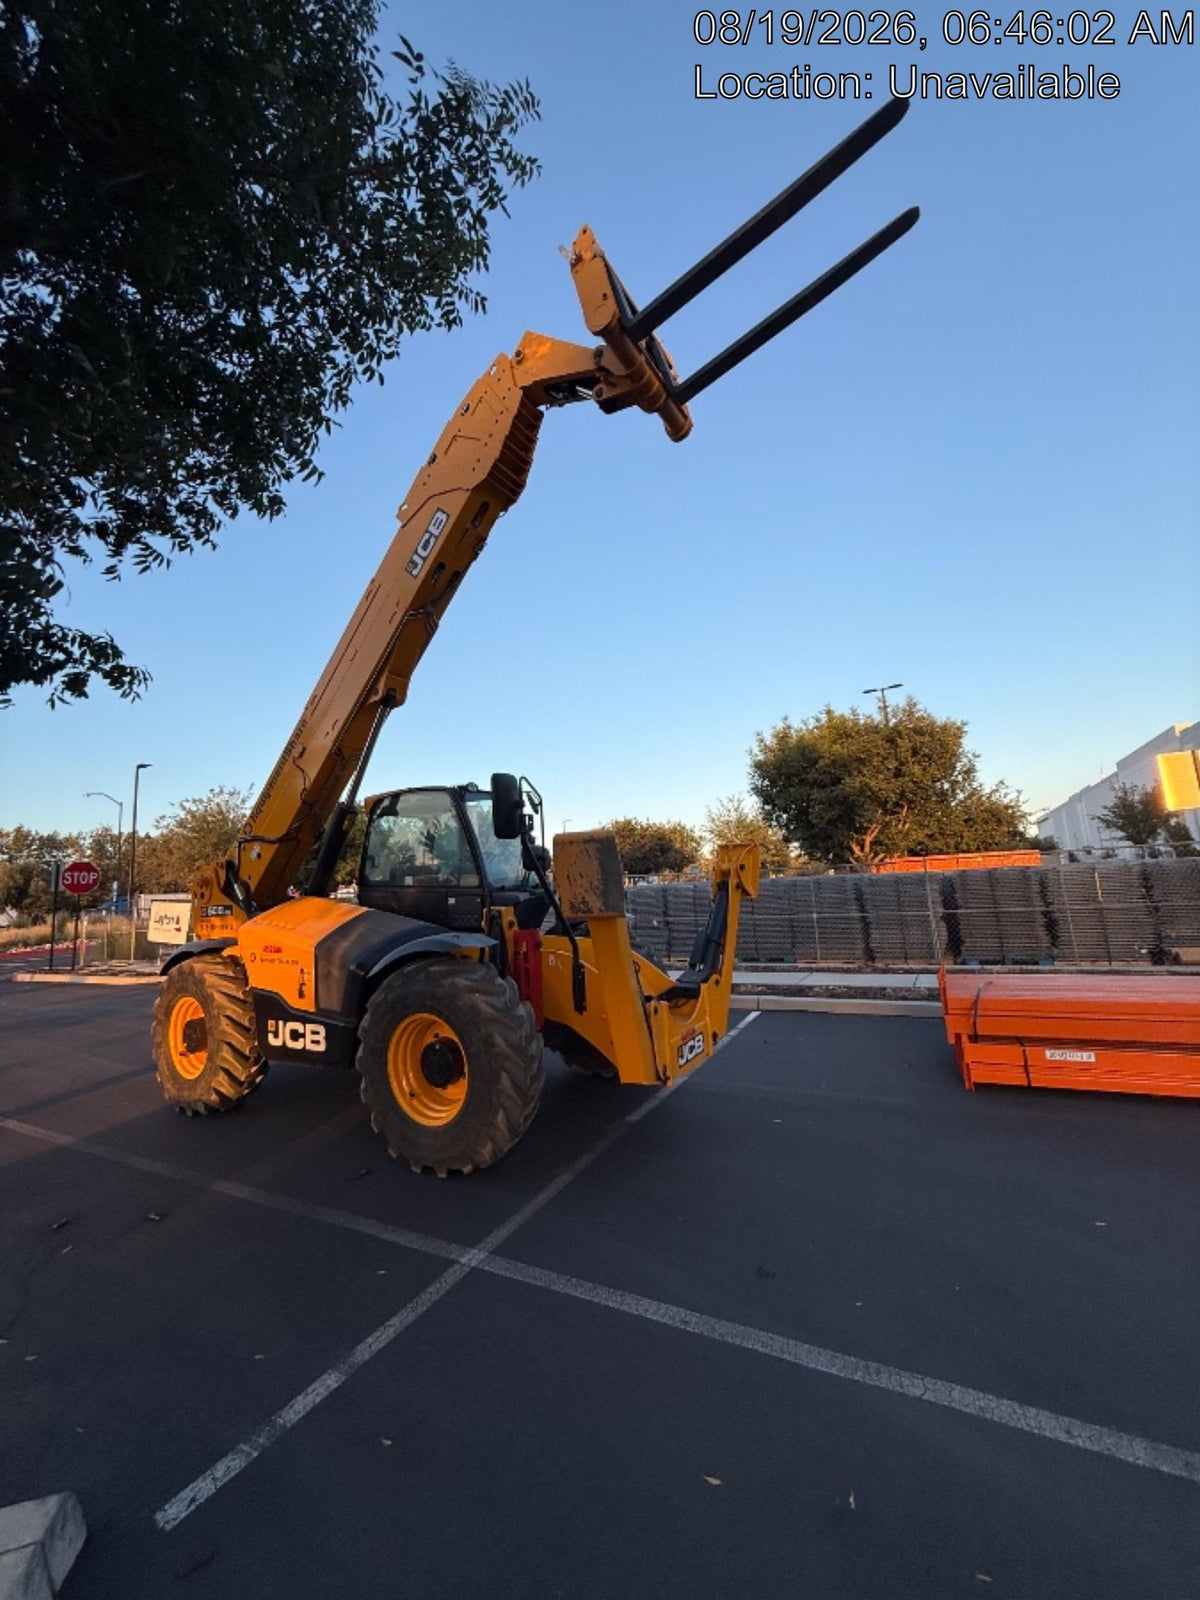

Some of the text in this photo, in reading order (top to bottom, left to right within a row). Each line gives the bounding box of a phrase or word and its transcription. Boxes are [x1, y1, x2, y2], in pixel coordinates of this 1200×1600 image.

[407, 509, 448, 577] JCB
[63, 870, 98, 885] STOP
[268, 1019, 327, 1052] JCB
[678, 1033, 704, 1066] JCB
